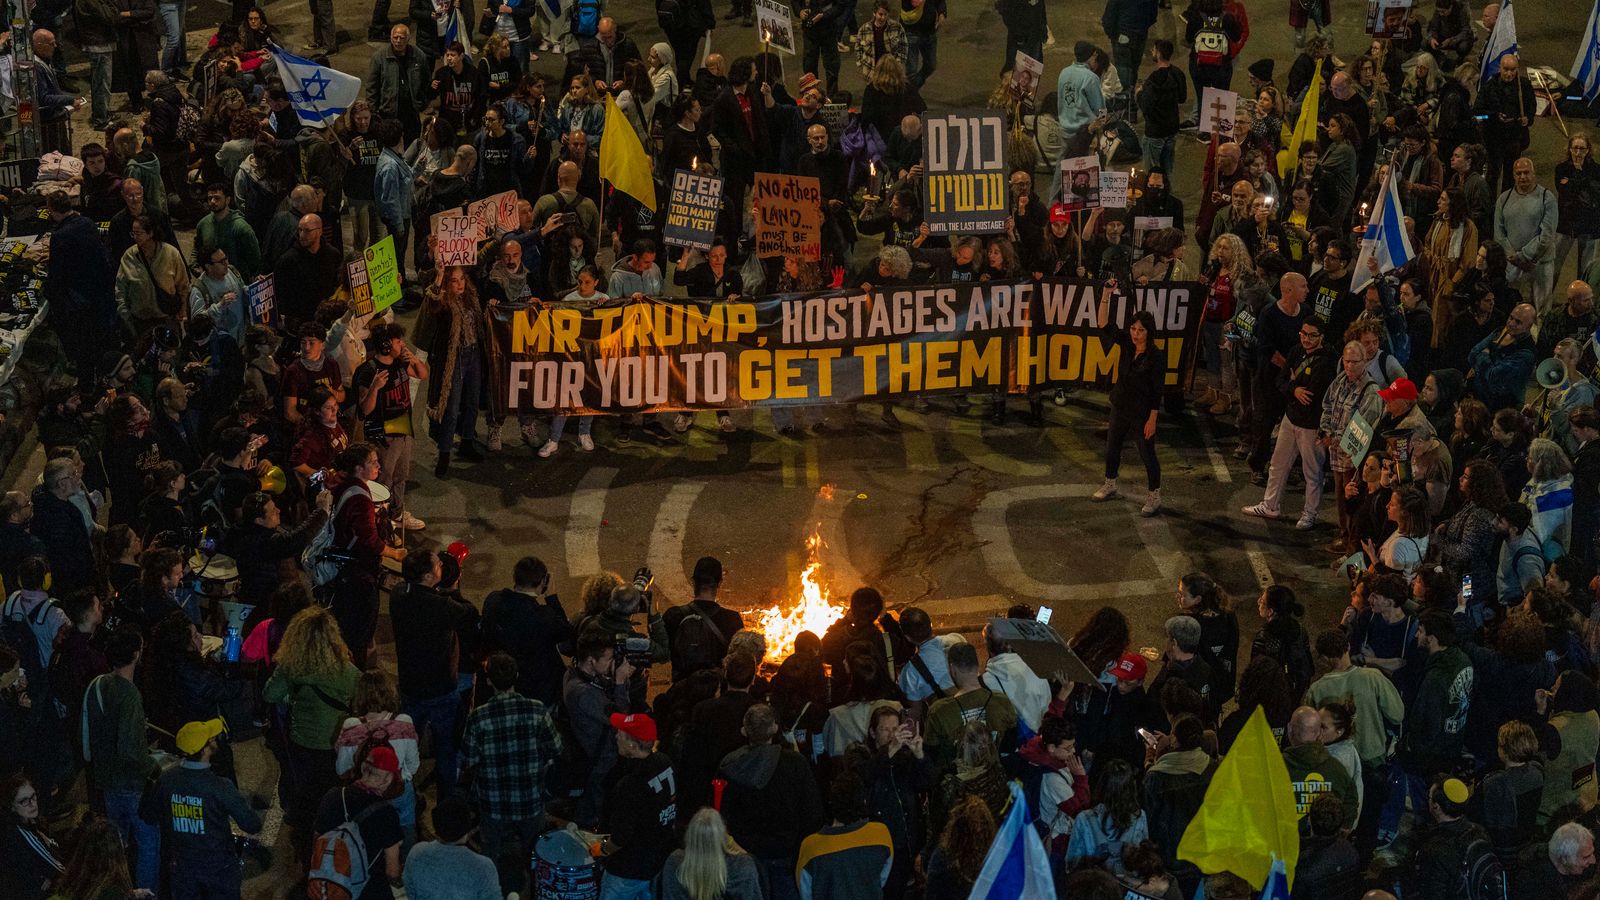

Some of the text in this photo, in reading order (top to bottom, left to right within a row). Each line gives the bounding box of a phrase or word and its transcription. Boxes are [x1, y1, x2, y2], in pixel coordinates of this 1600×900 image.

[928, 114, 1003, 171] כולם
[673, 172, 722, 198] OFER
[929, 173, 1004, 212] עכשיו!
[672, 190, 720, 209] IS BACK!
[670, 203, 717, 220] TOO MANY
[440, 216, 478, 232] STOP
[668, 213, 690, 228] NOT
[690, 217, 716, 232] YET!
[930, 222, 949, 232] UNTIL
[949, 222, 961, 231] THE
[960, 222, 976, 231] LAST
[448, 230, 465, 238] THE
[792, 231, 808, 243] BE
[439, 237, 477, 253] BLOODY
[441, 251, 476, 266] WAR!
[379, 271, 394, 290] STOP
[1316, 294, 1336, 308] LAST
[511, 308, 582, 354] MR
[593, 302, 768, 350] TRUMP,
[782, 287, 957, 344] HOSTAGES
[965, 283, 1034, 332] ARE
[508, 333, 1185, 408] FOR YOU TO GET THEM HOM!
[647, 765, 677, 796] די
[172, 794, 181, 804] ALL
[185, 796, 202, 806] THEM
[172, 804, 203, 819] HOME!
[173, 817, 205, 834] NOW!
